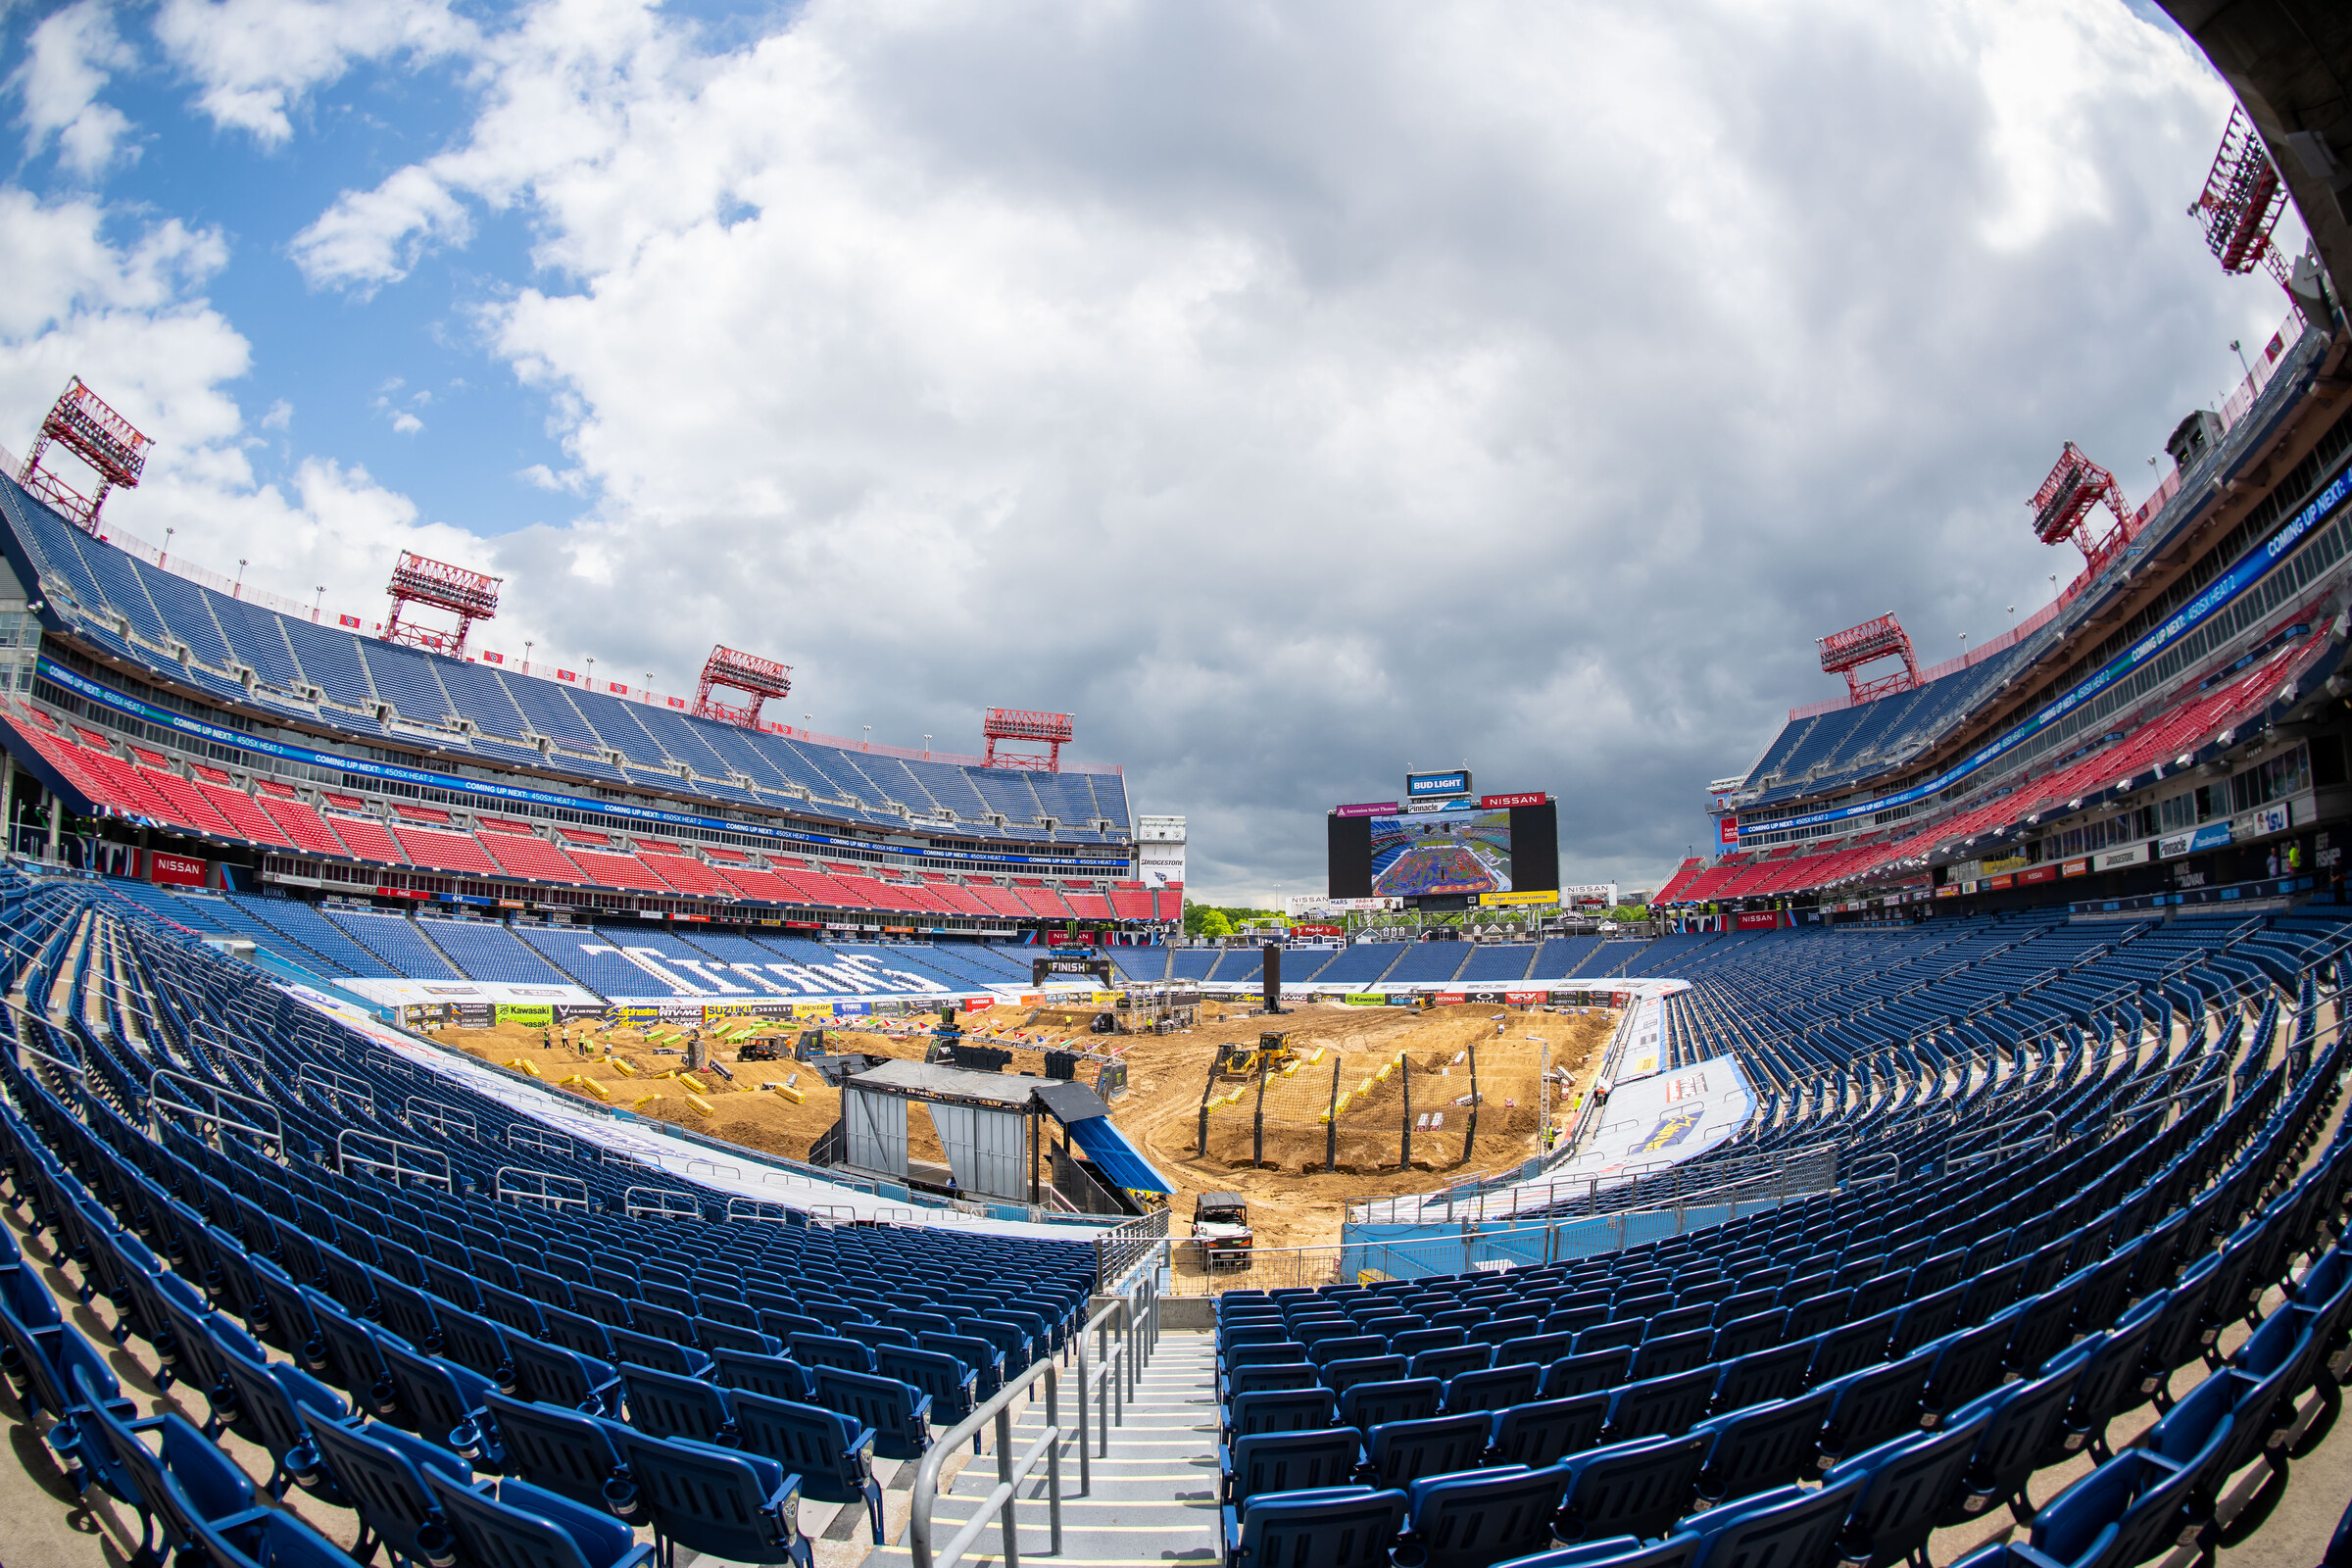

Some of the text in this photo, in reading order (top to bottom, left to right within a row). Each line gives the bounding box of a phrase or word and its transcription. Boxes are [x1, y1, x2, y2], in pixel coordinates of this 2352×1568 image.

[2267, 478, 2346, 558] COMING UP NEXT:
[2132, 574, 2236, 662] COMING UP NEXT: 450SX HEAT 2
[49, 665, 74, 685] COMING
[74, 677, 83, 688] UP
[103, 691, 124, 705] 450SX
[122, 697, 140, 711] HEAT
[172, 717, 202, 732] COMING
[202, 724, 213, 734] UP
[212, 728, 233, 742] NEXT:
[236, 734, 260, 747] 450SX
[260, 741, 277, 752] HEAT
[315, 755, 345, 767] COMING
[359, 763, 380, 773] NEXT:
[384, 767, 408, 778] 450SX
[408, 773, 428, 782] HEAT
[1434, 779, 1461, 788] LIGHT
[466, 782, 495, 793] COMING
[508, 789, 528, 799] NEXT:
[531, 793, 553, 802] 450SX
[1409, 804, 1439, 812] Pinnacle
[1490, 796, 1537, 806] NISSAN
[1846, 806, 1866, 814] COMING
[1886, 797, 1898, 806] 450SX
[1897, 793, 1909, 802] HEAT
[604, 805, 631, 814] COMING
[641, 810, 660, 819] NEXT:
[662, 813, 681, 822] 450SX
[725, 822, 749, 832] COMING
[2106, 851, 2134, 865] BRIDGESTONE
[158, 858, 200, 875] NISSAN
[348, 897, 371, 906] HONOR
[1488, 894, 1506, 904] Kroger
[1556, 911, 1568, 923] JACK
[578, 945, 951, 997] TITANS
[1052, 961, 1086, 972] FINISH
[511, 1005, 550, 1014] Kawasaki
[620, 1006, 659, 1017] alpinestars
[707, 1005, 750, 1015] SUZUKI
[683, 1077, 700, 1091] DUNLOP
